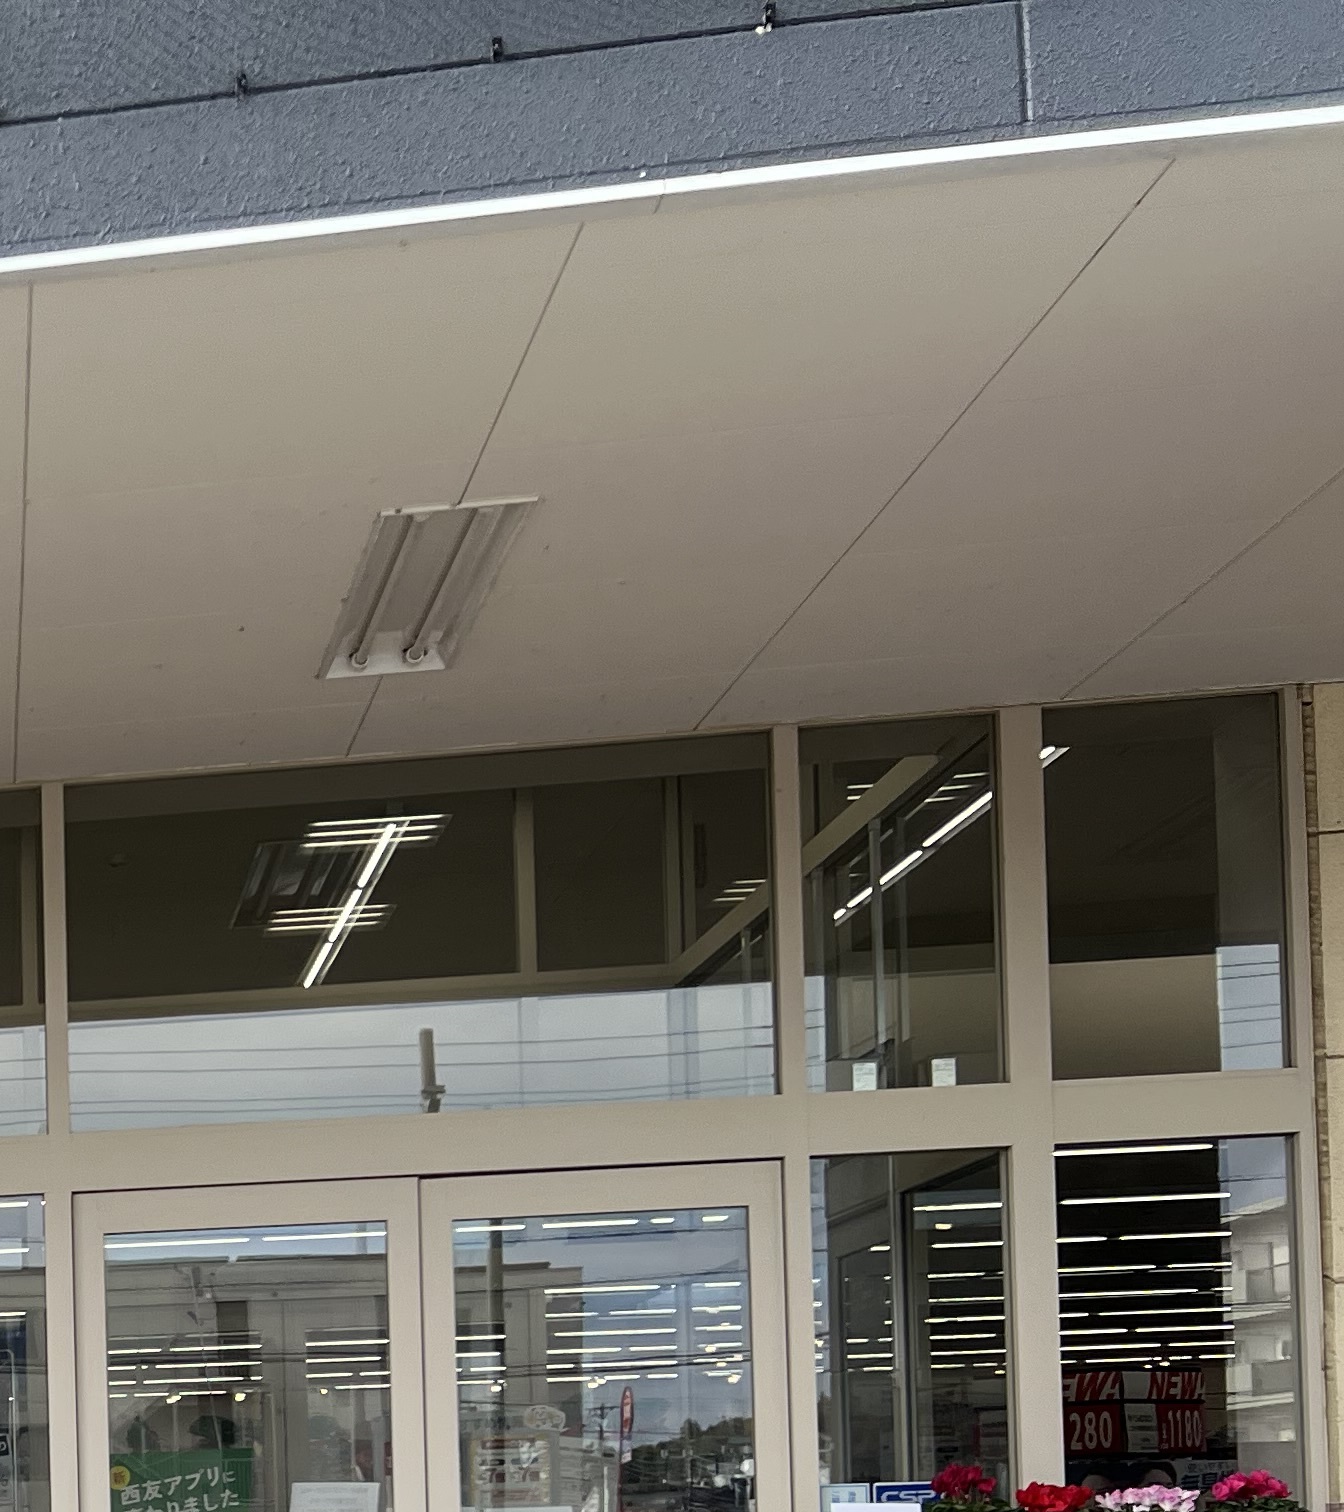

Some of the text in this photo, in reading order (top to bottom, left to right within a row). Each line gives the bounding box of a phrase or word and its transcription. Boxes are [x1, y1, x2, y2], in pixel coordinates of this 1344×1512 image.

[121, 1466, 236, 1505] 西友アプリに
